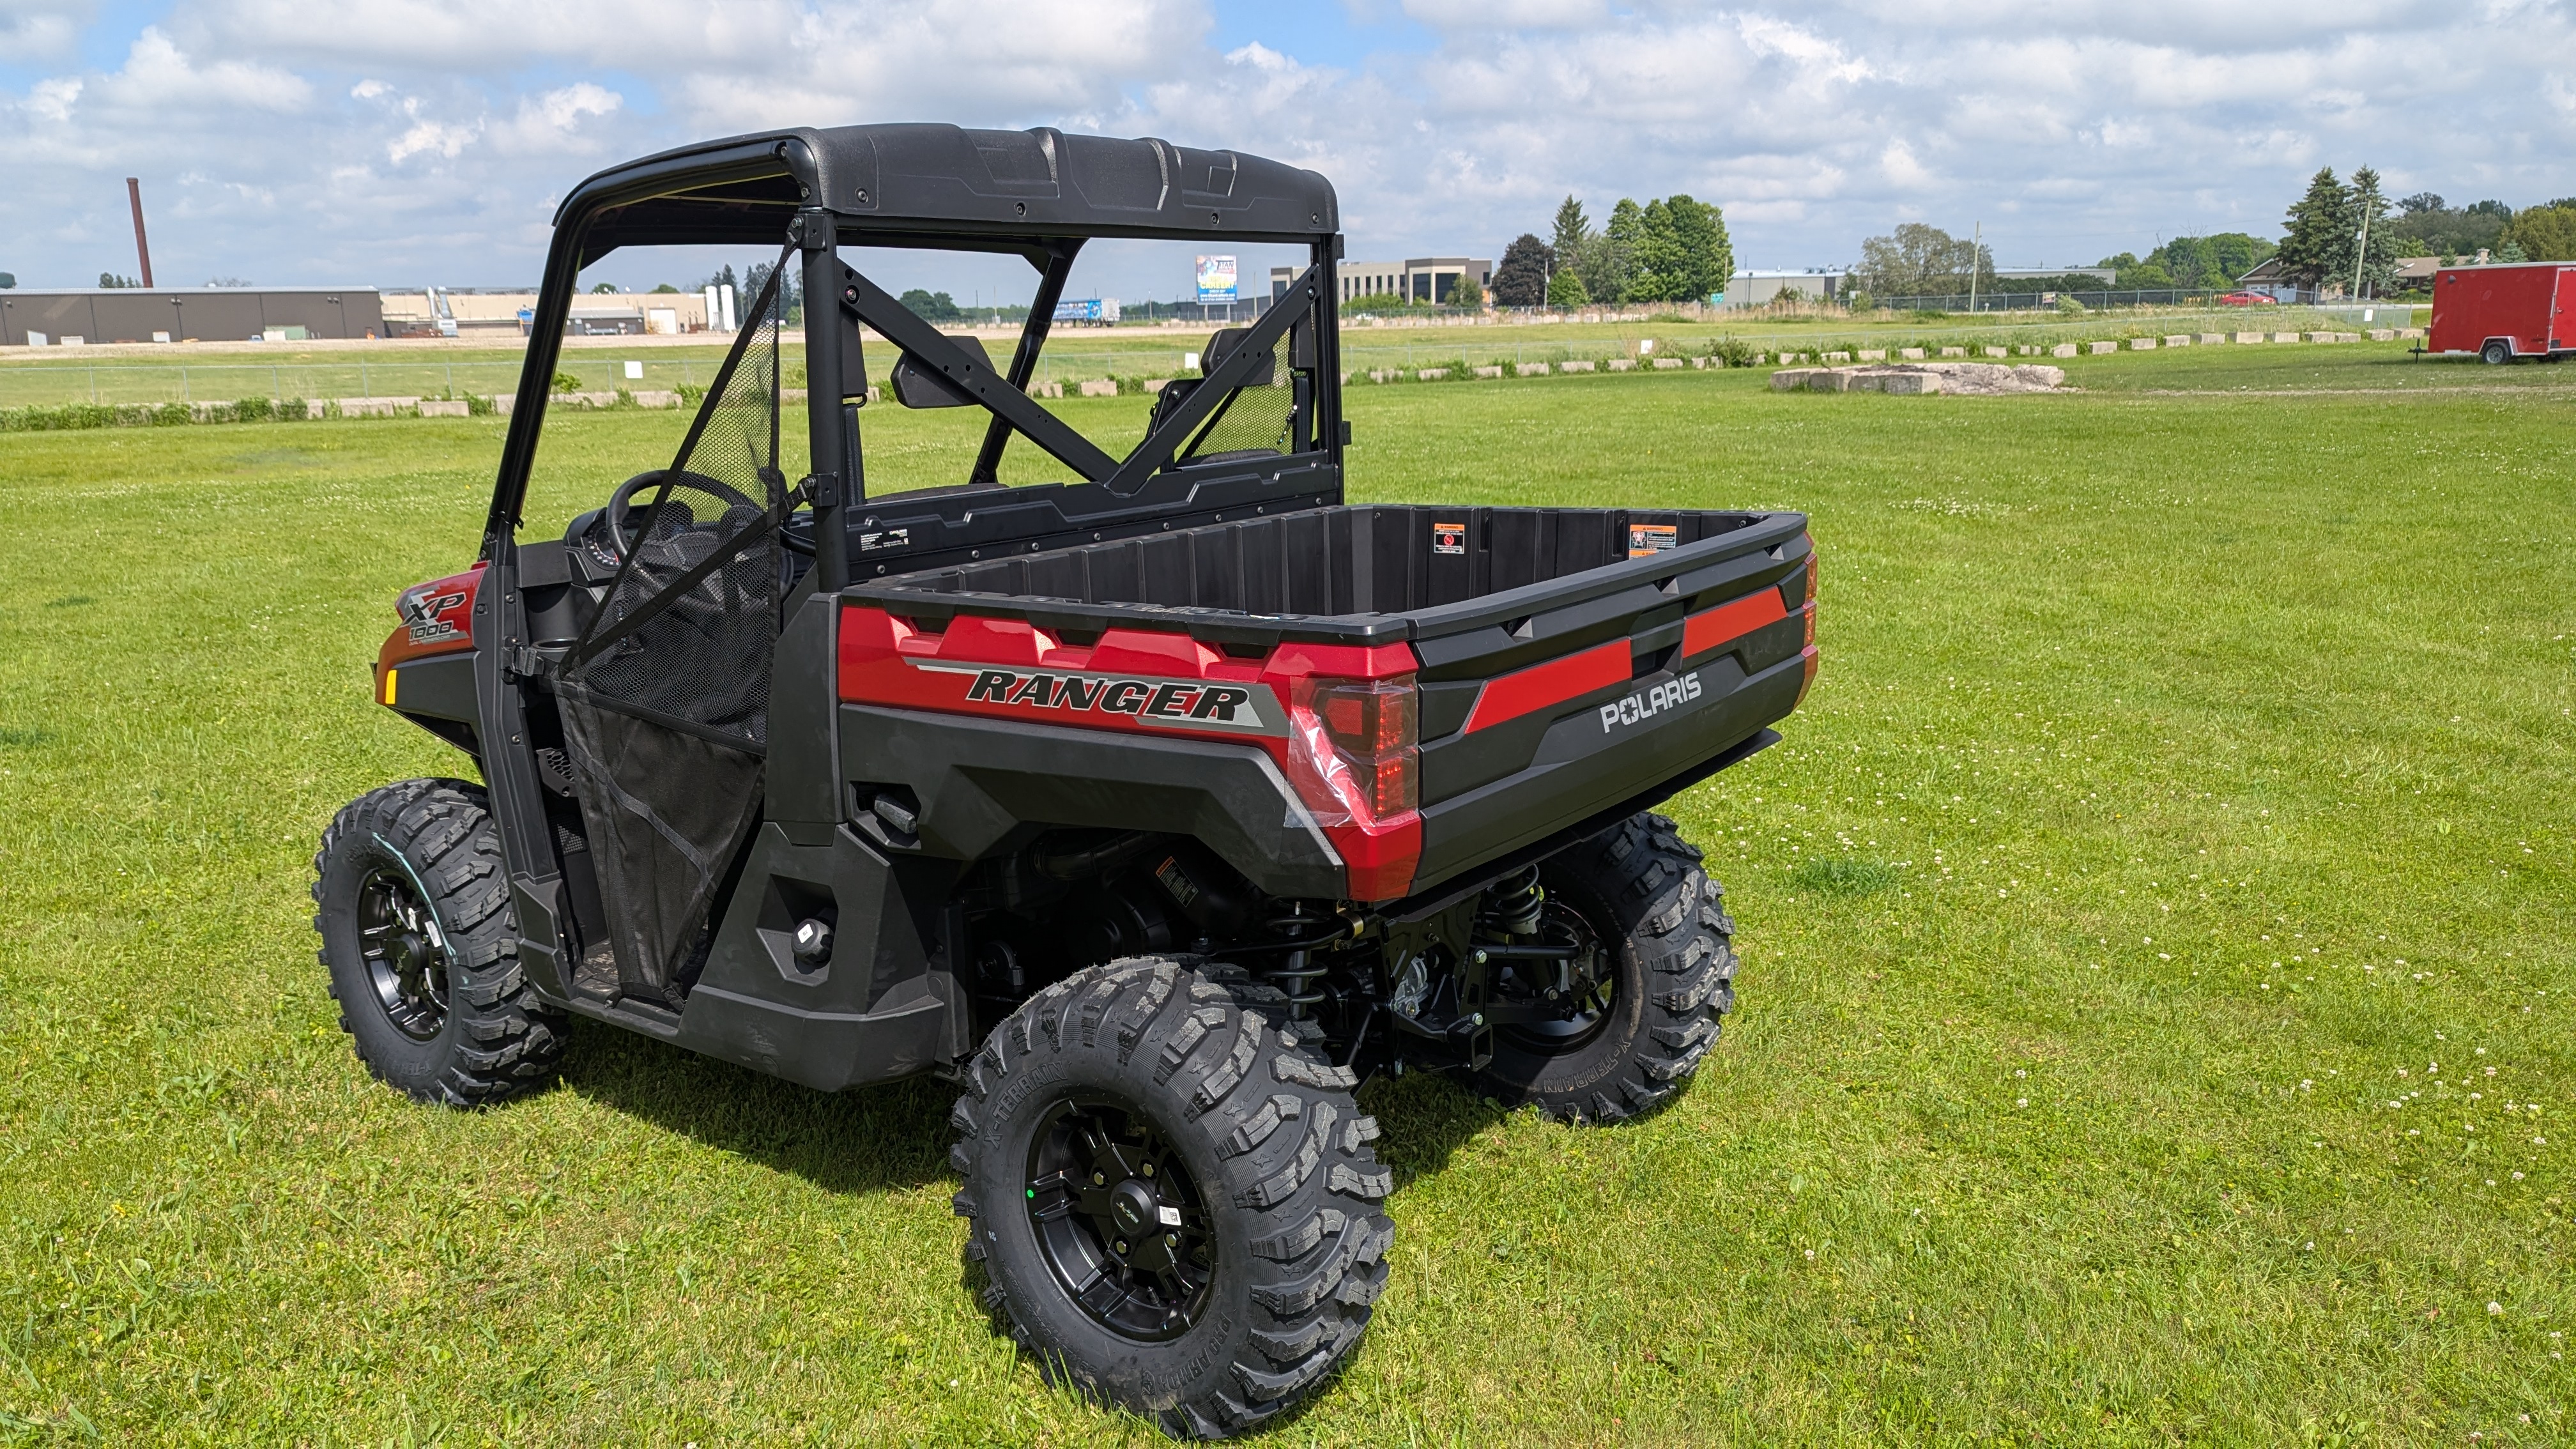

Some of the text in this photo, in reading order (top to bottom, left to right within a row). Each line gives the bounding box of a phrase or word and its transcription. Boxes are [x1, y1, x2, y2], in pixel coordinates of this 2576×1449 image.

[1215, 259, 1234, 270] TITAN
[401, 592, 466, 627] XP
[409, 620, 454, 641] 1000
[965, 669, 1249, 722] RANGER
[1600, 671, 1702, 733] POLARIS
[1544, 1033, 1632, 1094] X-TERRAIN
[984, 1061, 1068, 1150] X-TERRAIN
[1157, 1347, 1211, 1392] ARMOR
